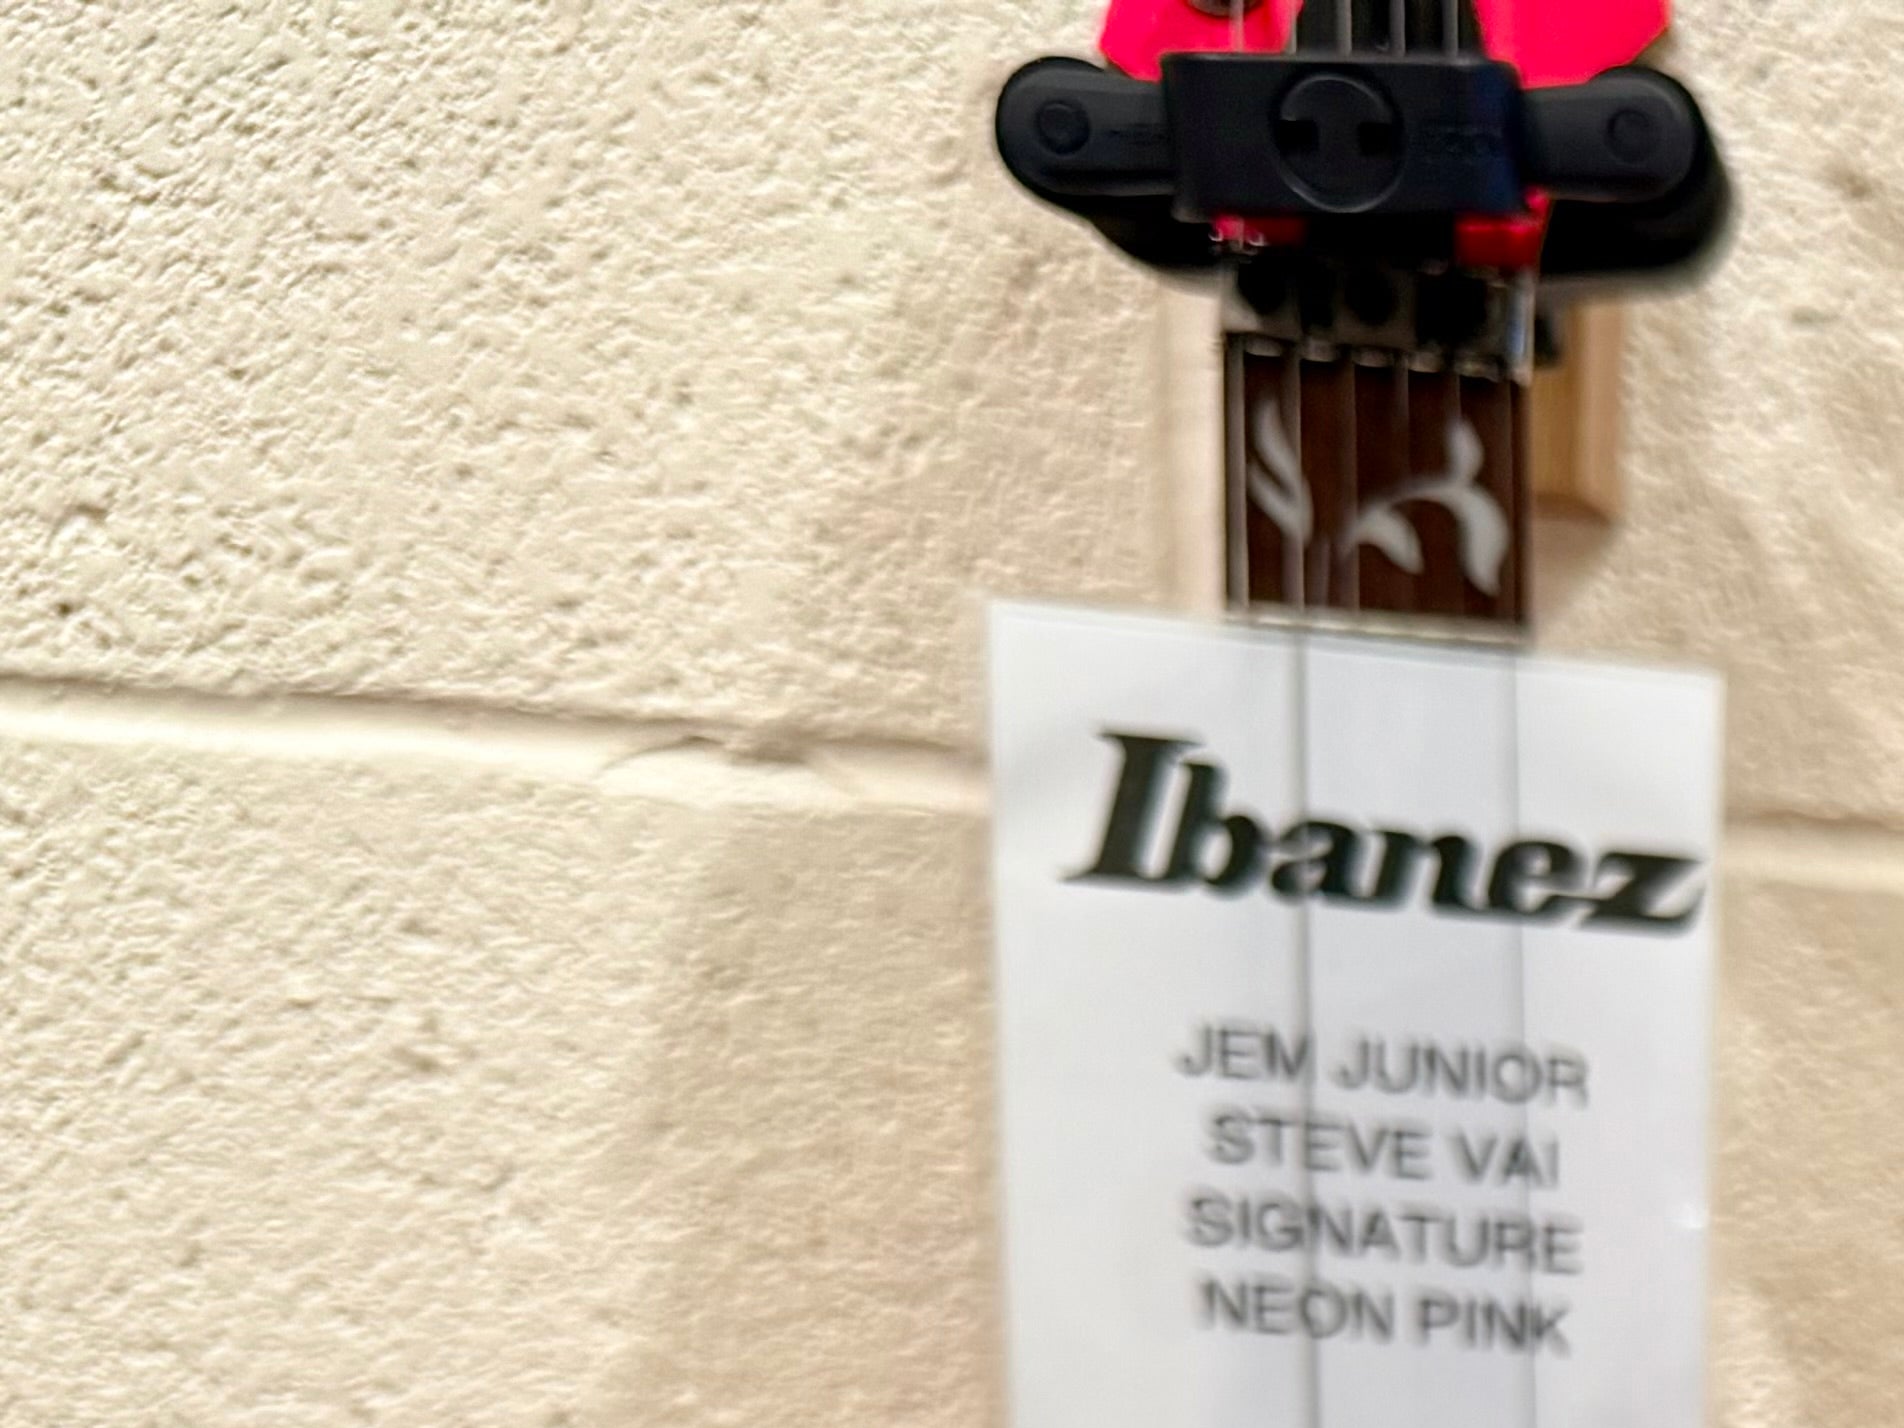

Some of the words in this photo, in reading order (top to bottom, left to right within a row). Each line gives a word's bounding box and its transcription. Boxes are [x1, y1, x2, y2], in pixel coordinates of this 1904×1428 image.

[1062, 728, 1706, 934] Ibanez
[1175, 1025, 1313, 1085] JEM
[1331, 1040, 1589, 1108] JUNIOR
[1208, 1111, 1431, 1180] STEVE
[1451, 1137, 1560, 1188] VAI
[1186, 1195, 1585, 1277] SIGNATURE
[1197, 1278, 1396, 1346] NEON
[1414, 1302, 1571, 1356] PINK
